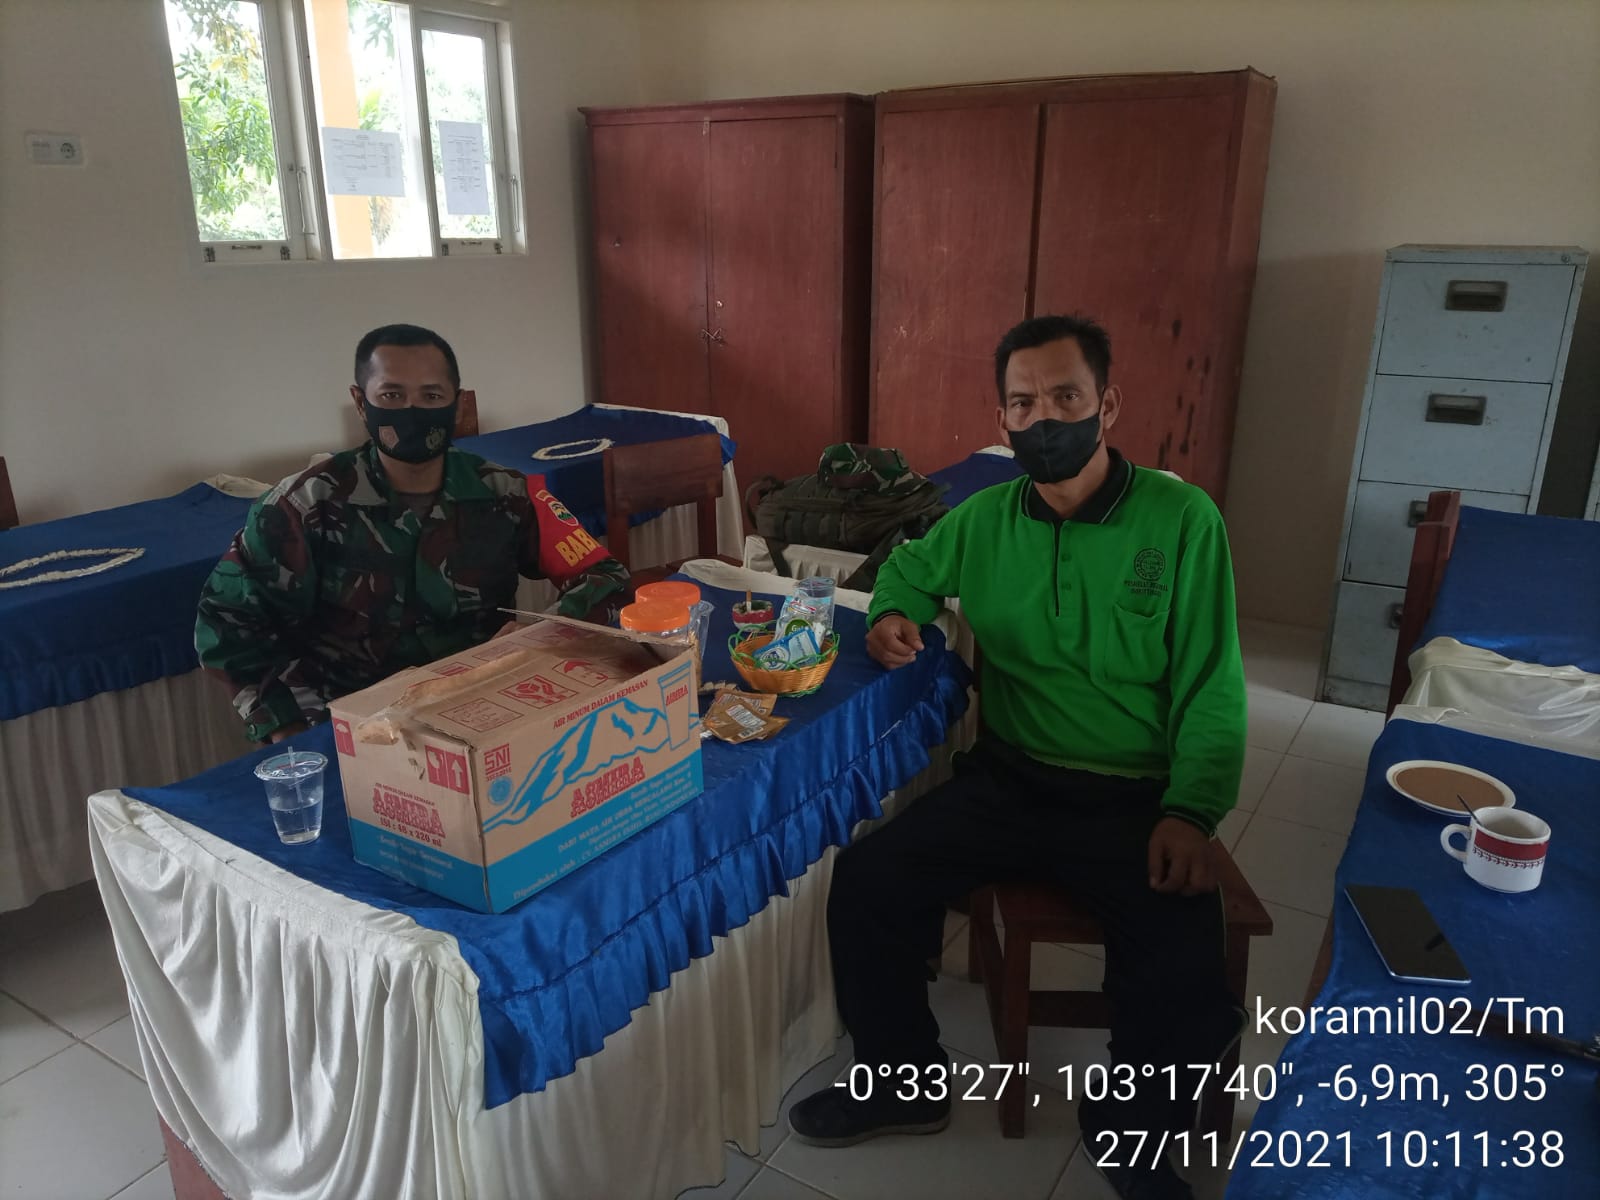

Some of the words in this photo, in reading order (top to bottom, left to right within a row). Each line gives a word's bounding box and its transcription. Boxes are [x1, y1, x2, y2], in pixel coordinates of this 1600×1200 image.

[591, 693, 616, 711] DALAM
[616, 679, 649, 699] KEMASAN
[484, 746, 511, 772] SNI
[415, 830, 431, 843] 220
